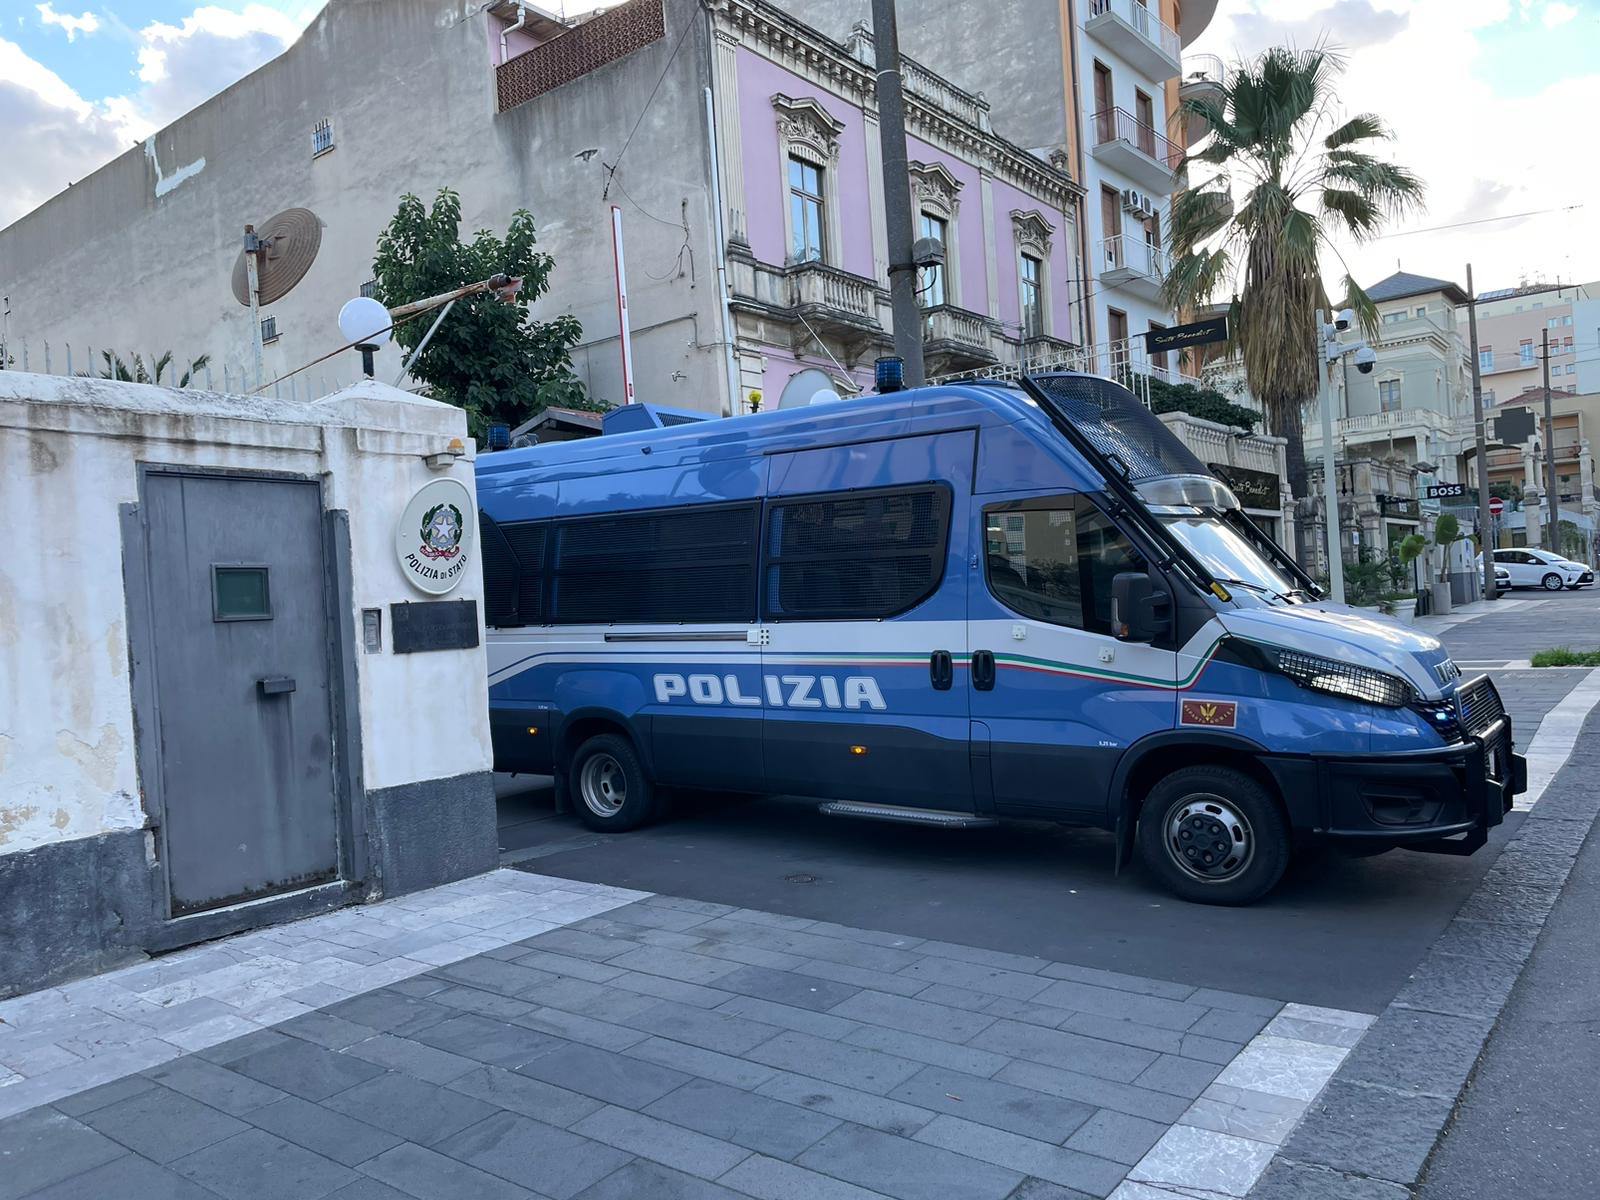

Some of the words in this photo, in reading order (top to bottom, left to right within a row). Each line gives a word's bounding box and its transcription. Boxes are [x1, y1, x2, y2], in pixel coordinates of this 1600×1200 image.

[1430, 486, 1462, 497] BOSS
[404, 553, 438, 580] POLIZIA
[440, 572, 447, 580] DI
[447, 554, 467, 578] STATO
[653, 673, 887, 710] POLIZIA
